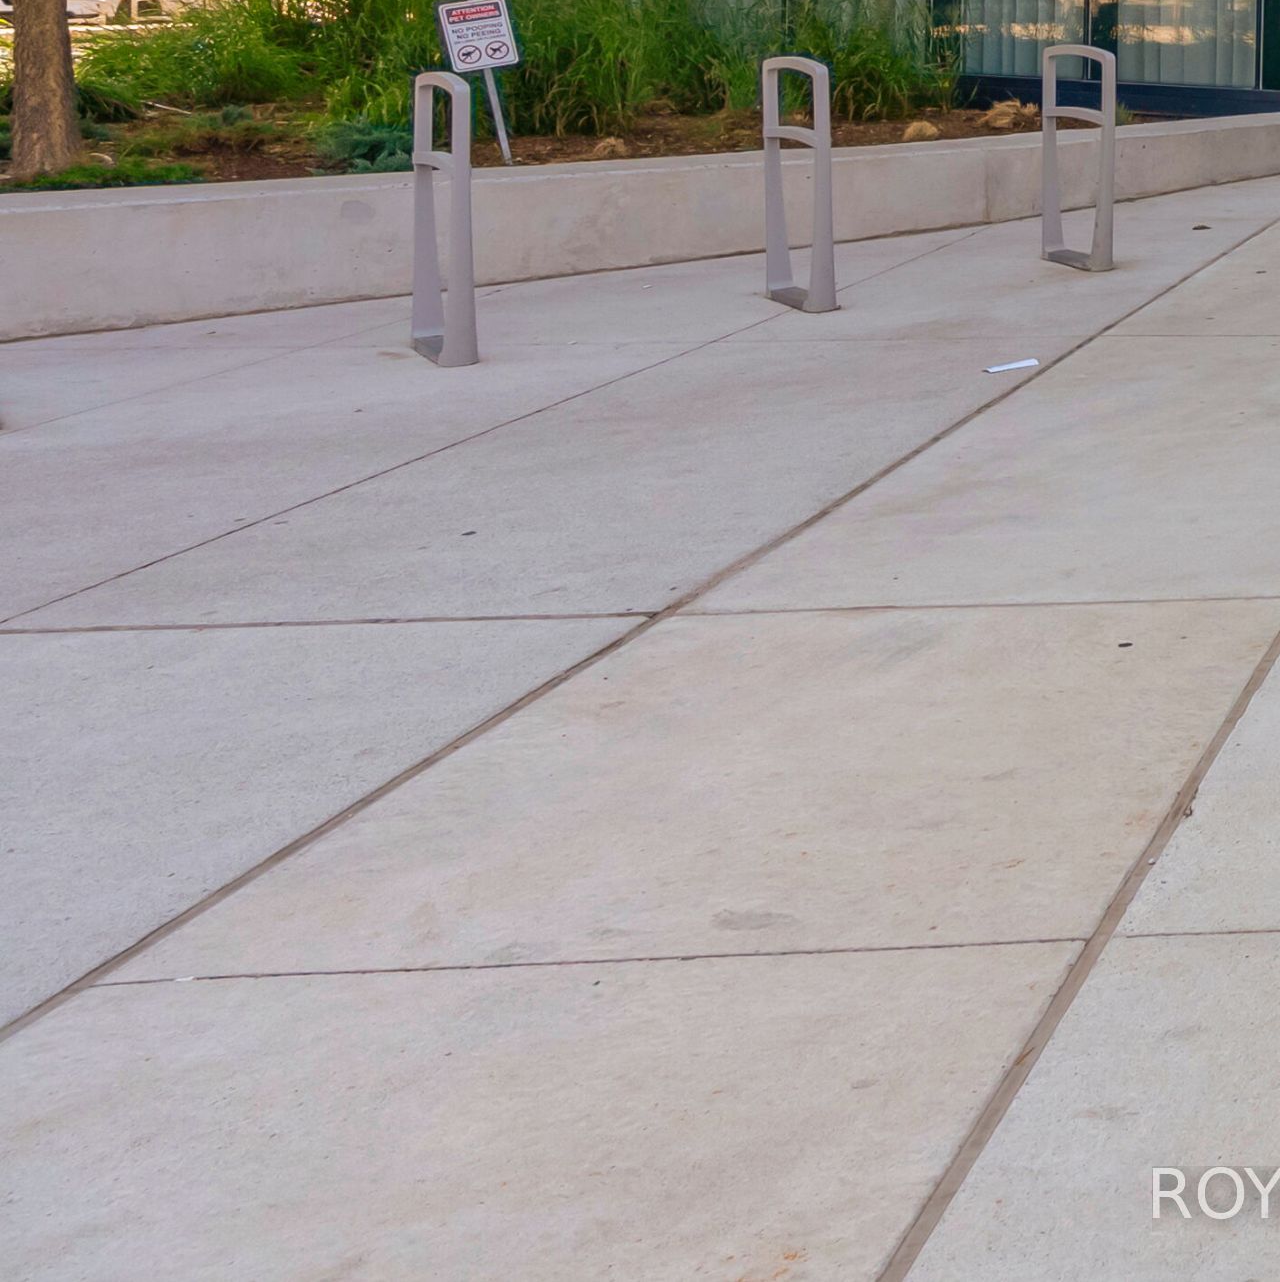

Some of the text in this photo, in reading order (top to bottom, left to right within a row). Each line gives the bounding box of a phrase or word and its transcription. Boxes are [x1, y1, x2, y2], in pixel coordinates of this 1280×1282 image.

[451, 4, 496, 16] ATTENTION
[466, 21, 503, 32] POOPING
[471, 28, 501, 38] PEEING
